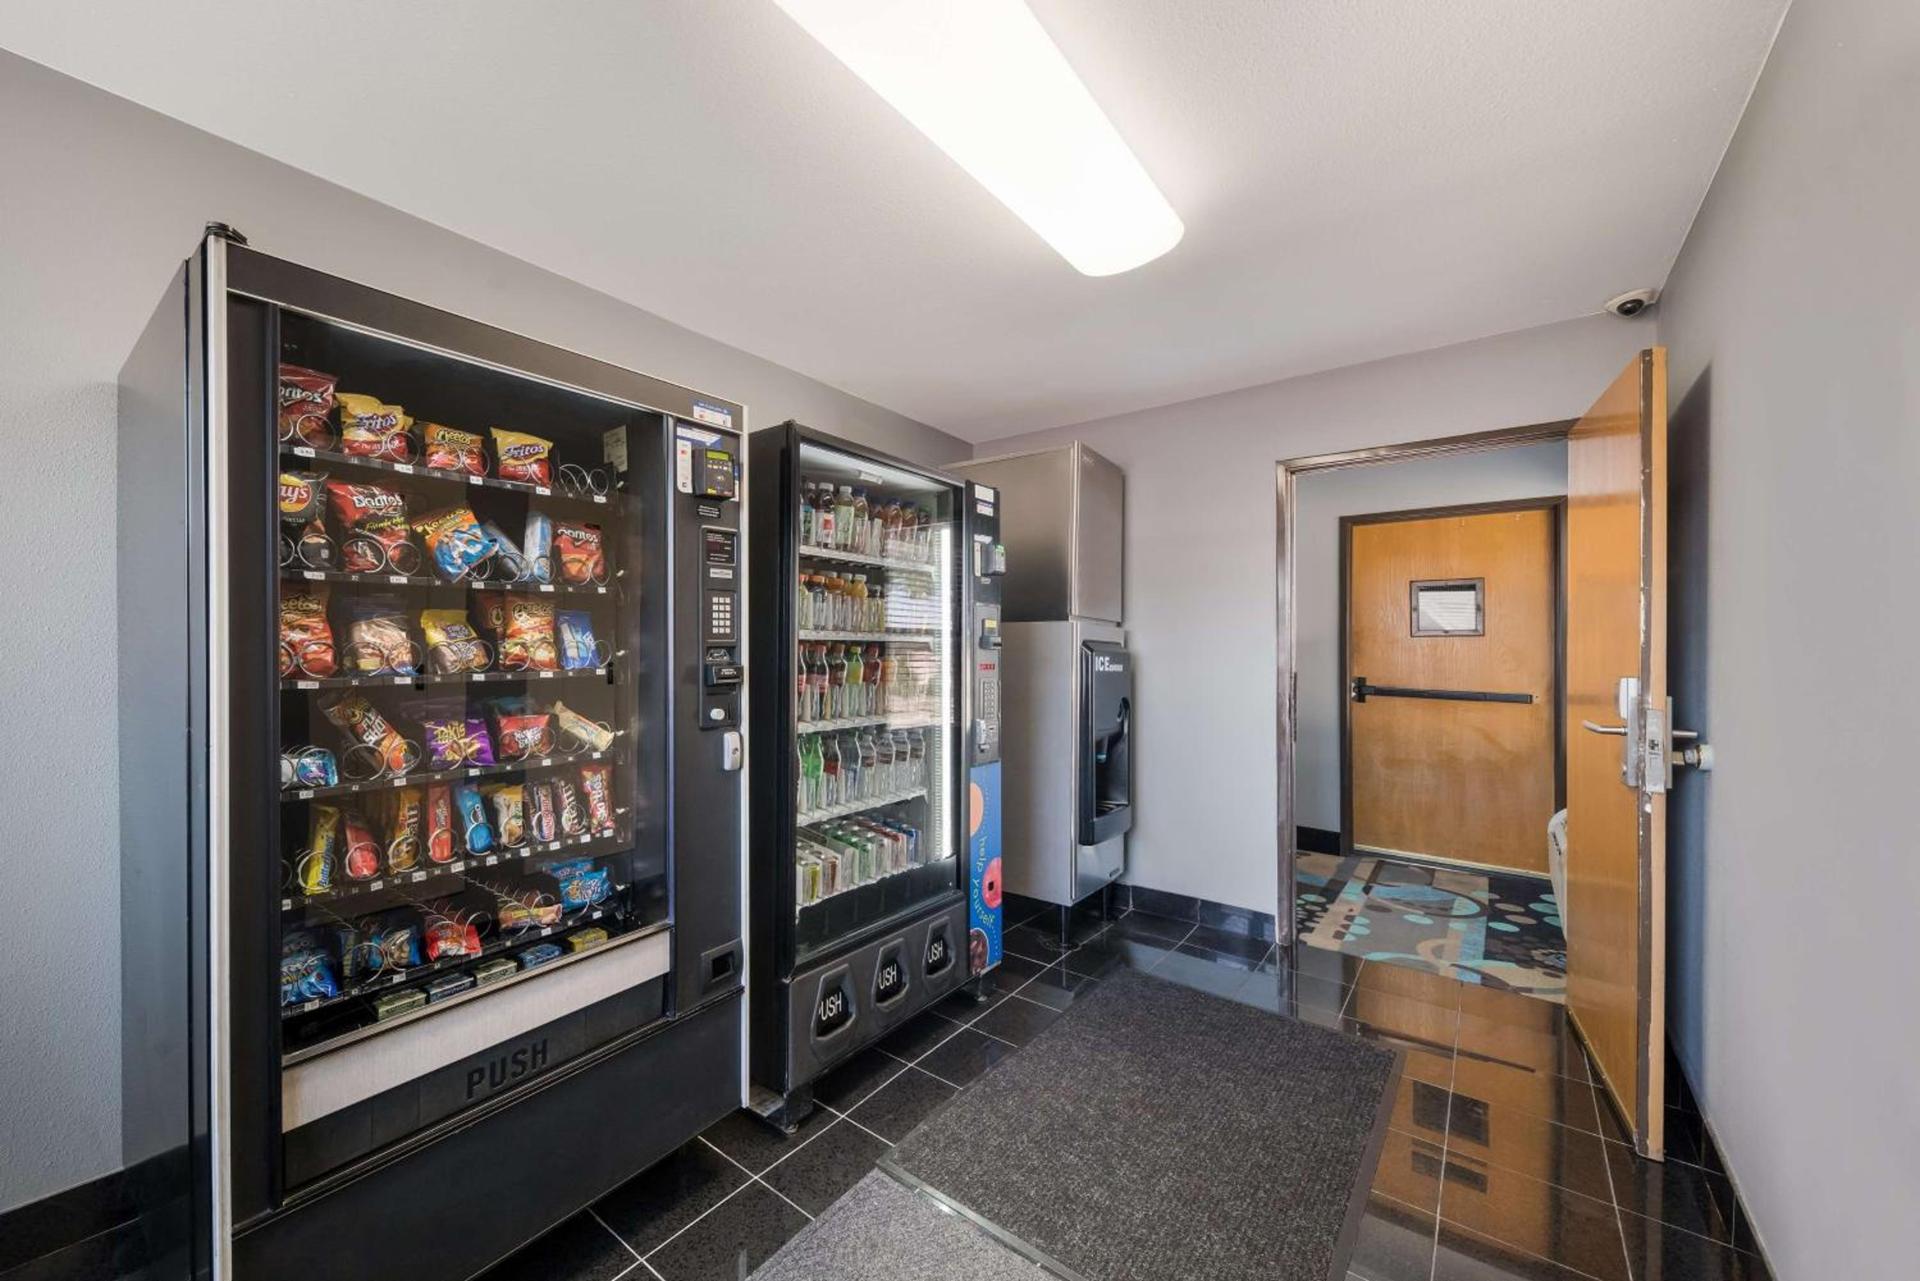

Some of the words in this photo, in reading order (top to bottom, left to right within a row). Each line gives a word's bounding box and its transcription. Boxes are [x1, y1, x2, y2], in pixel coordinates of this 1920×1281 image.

[1095, 656, 1110, 672] ICE
[976, 835, 988, 872] help
[927, 940, 943, 964] USH
[878, 963, 897, 990] USH
[818, 991, 843, 1021] USH
[466, 1038, 549, 1100] PUSH
